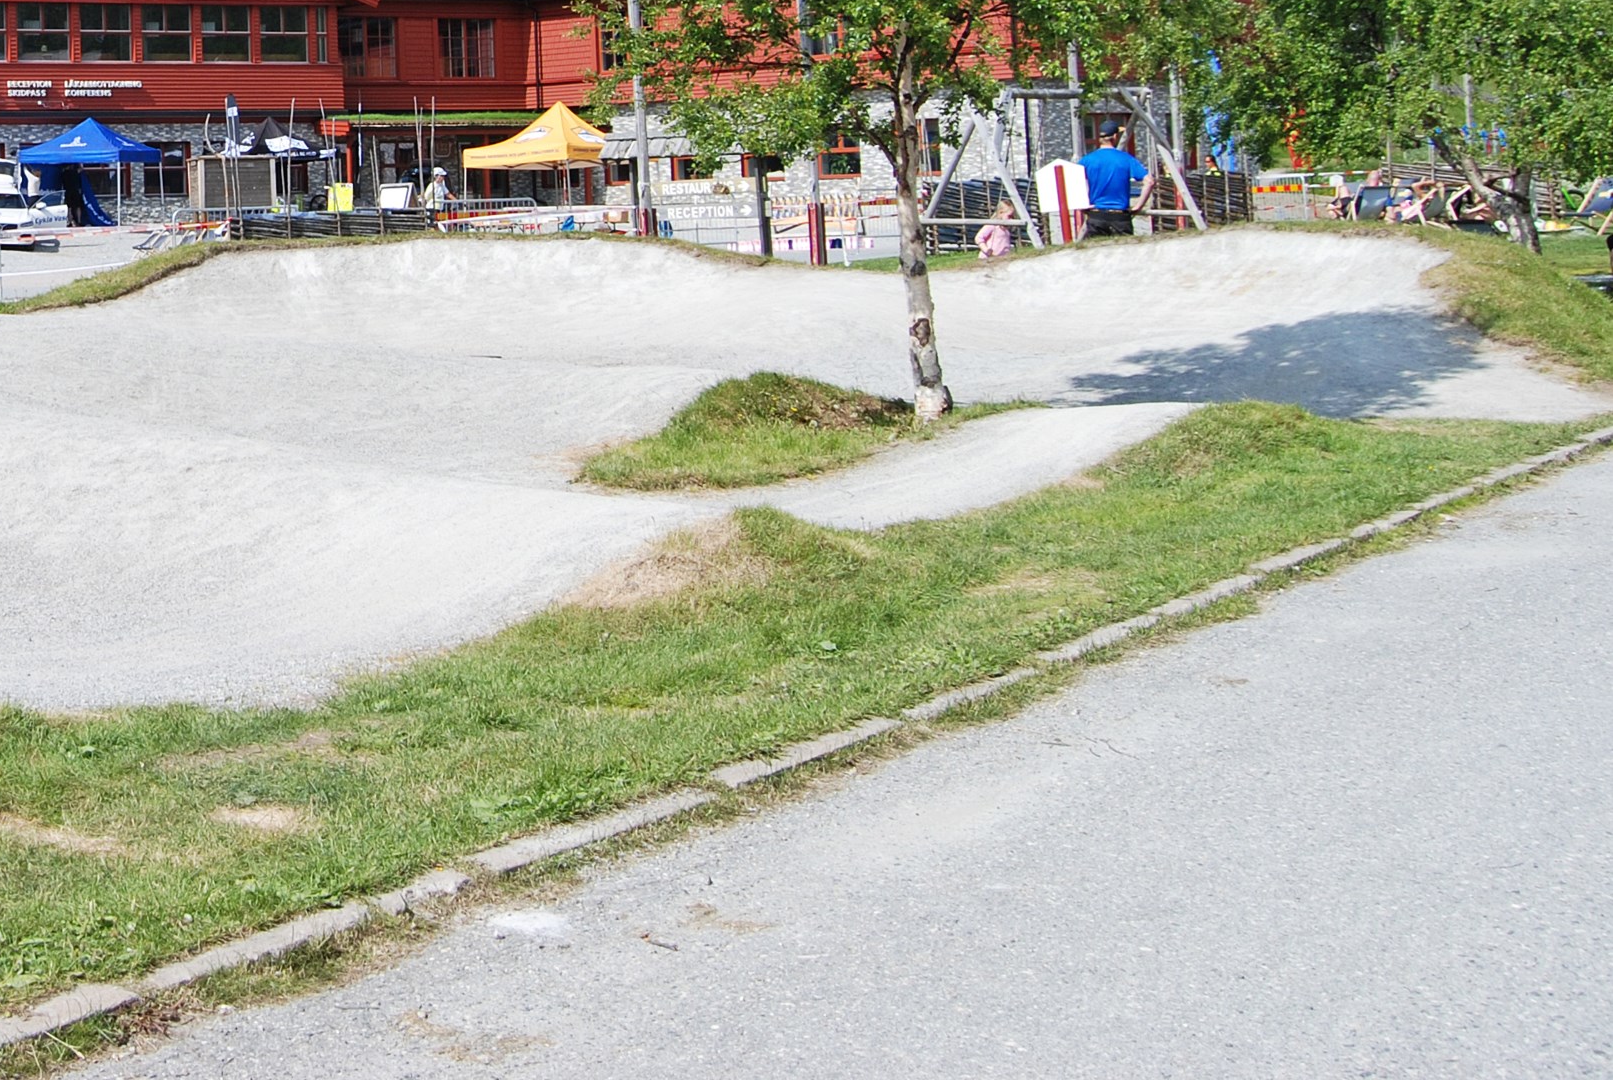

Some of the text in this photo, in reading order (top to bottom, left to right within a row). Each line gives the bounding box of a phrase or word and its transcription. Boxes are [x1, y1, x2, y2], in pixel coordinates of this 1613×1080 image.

[6, 80, 52, 89] RECEPTION
[7, 89, 47, 97] SKIDPASS
[64, 89, 112, 97] KONFERENS
[661, 181, 735, 196] RESTAURG
[667, 205, 734, 219] RECEPTION
